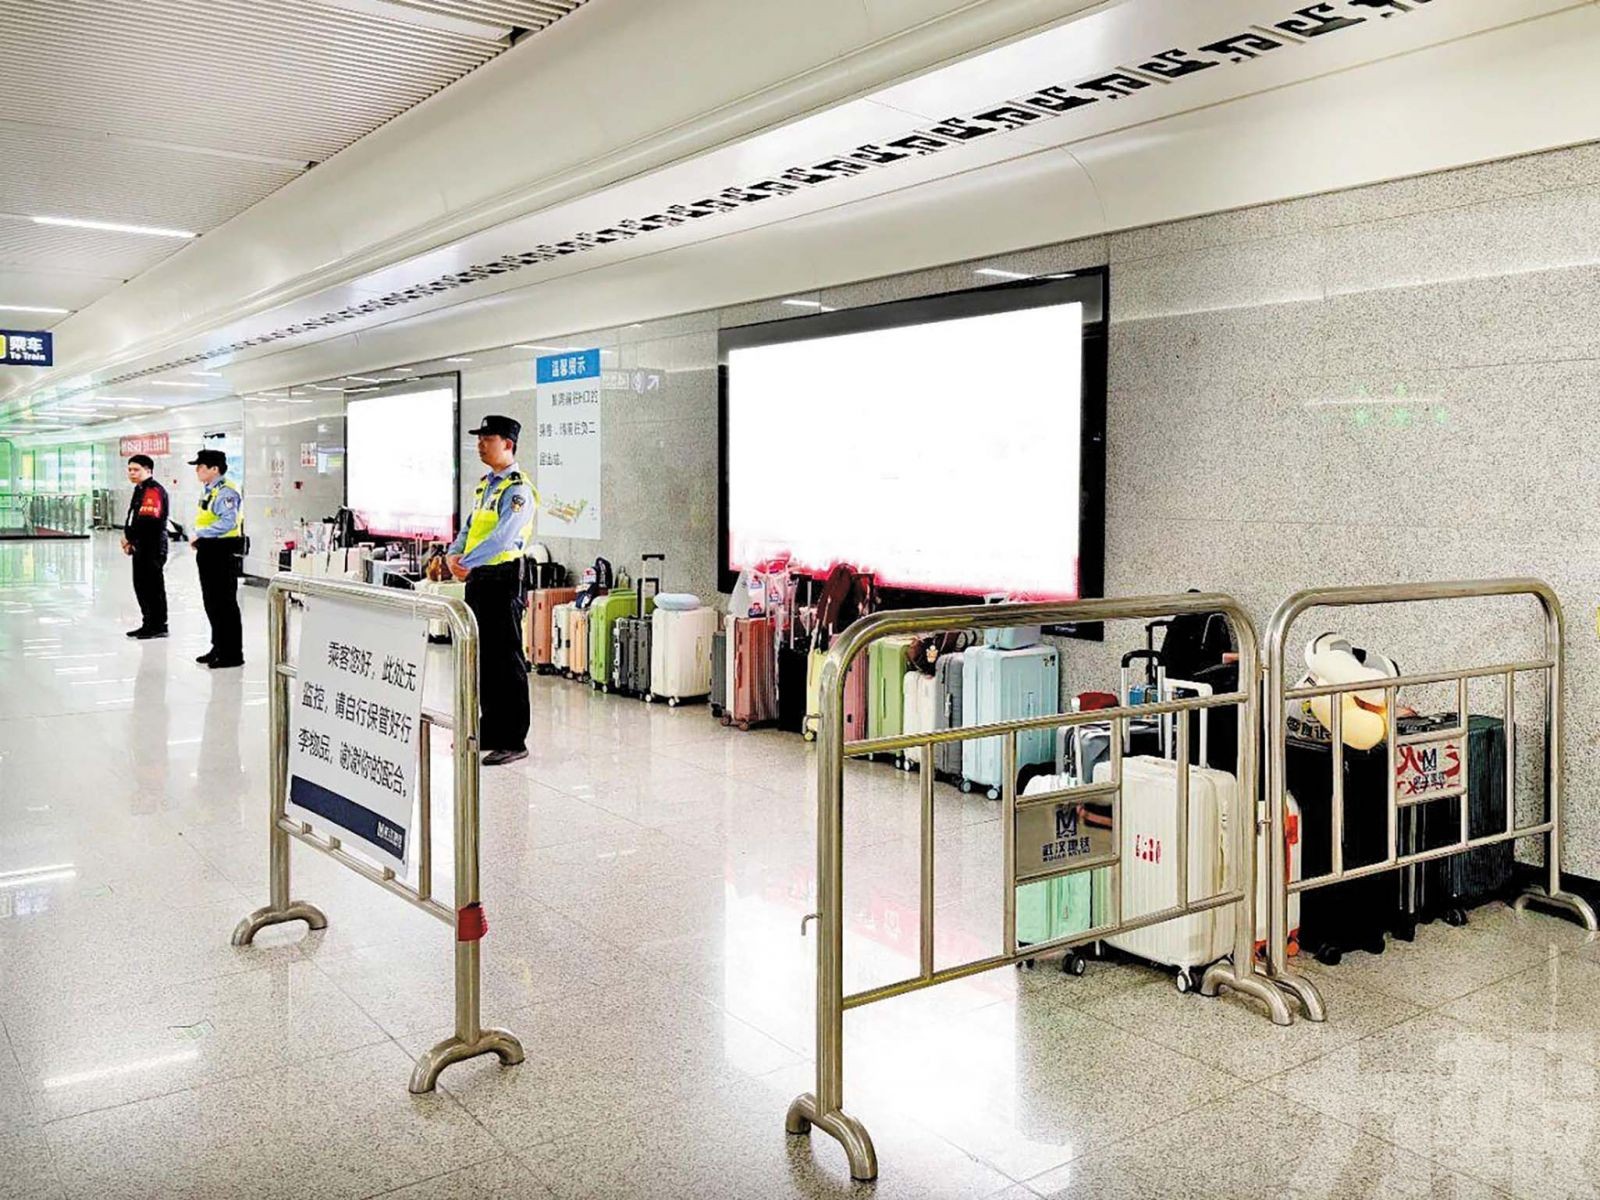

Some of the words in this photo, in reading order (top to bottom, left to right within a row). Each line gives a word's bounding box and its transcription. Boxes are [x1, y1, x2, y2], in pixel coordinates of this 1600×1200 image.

[9, 336, 43, 352] 乘车
[10, 352, 21, 360] To
[23, 352, 46, 361] Train
[551, 356, 586, 377] 温馨提示
[1042, 836, 1090, 857] 武汉地铁
